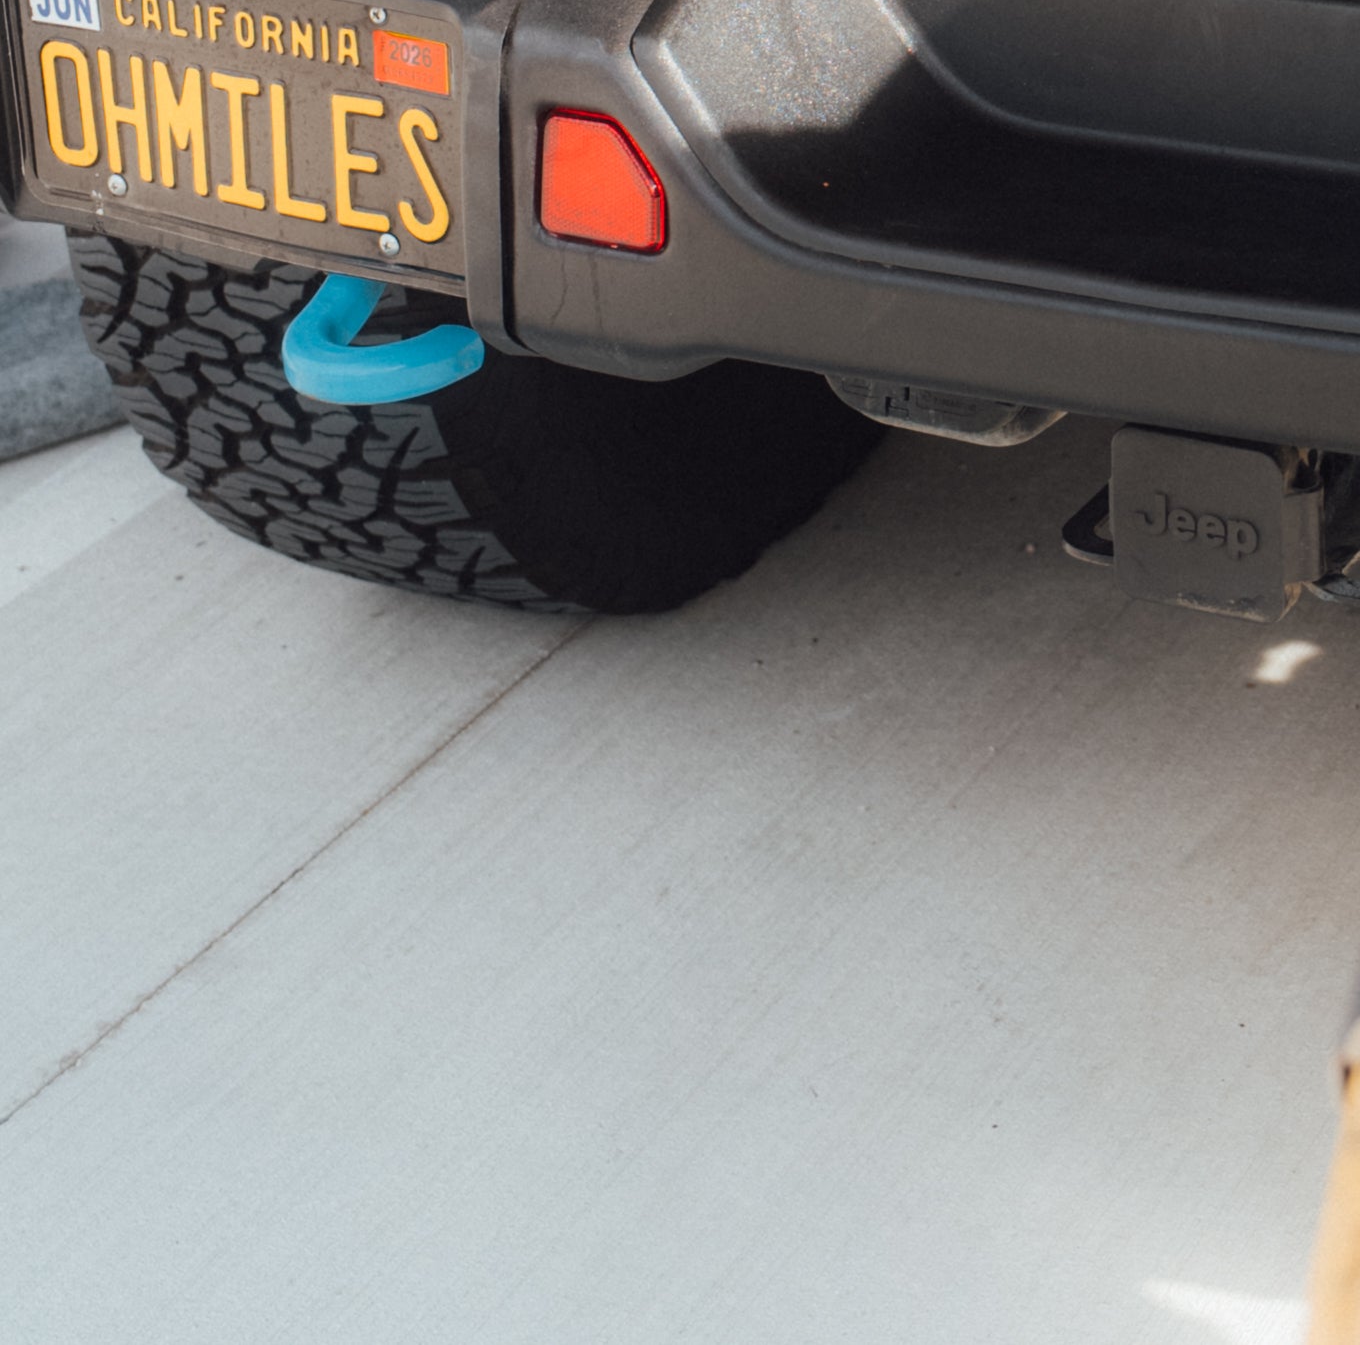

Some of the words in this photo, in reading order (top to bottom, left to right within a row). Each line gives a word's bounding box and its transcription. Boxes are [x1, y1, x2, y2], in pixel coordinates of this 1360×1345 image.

[388, 40, 433, 68] 2026
[40, 40, 450, 242] OHMILES
[1135, 492, 1260, 561] Jeep
